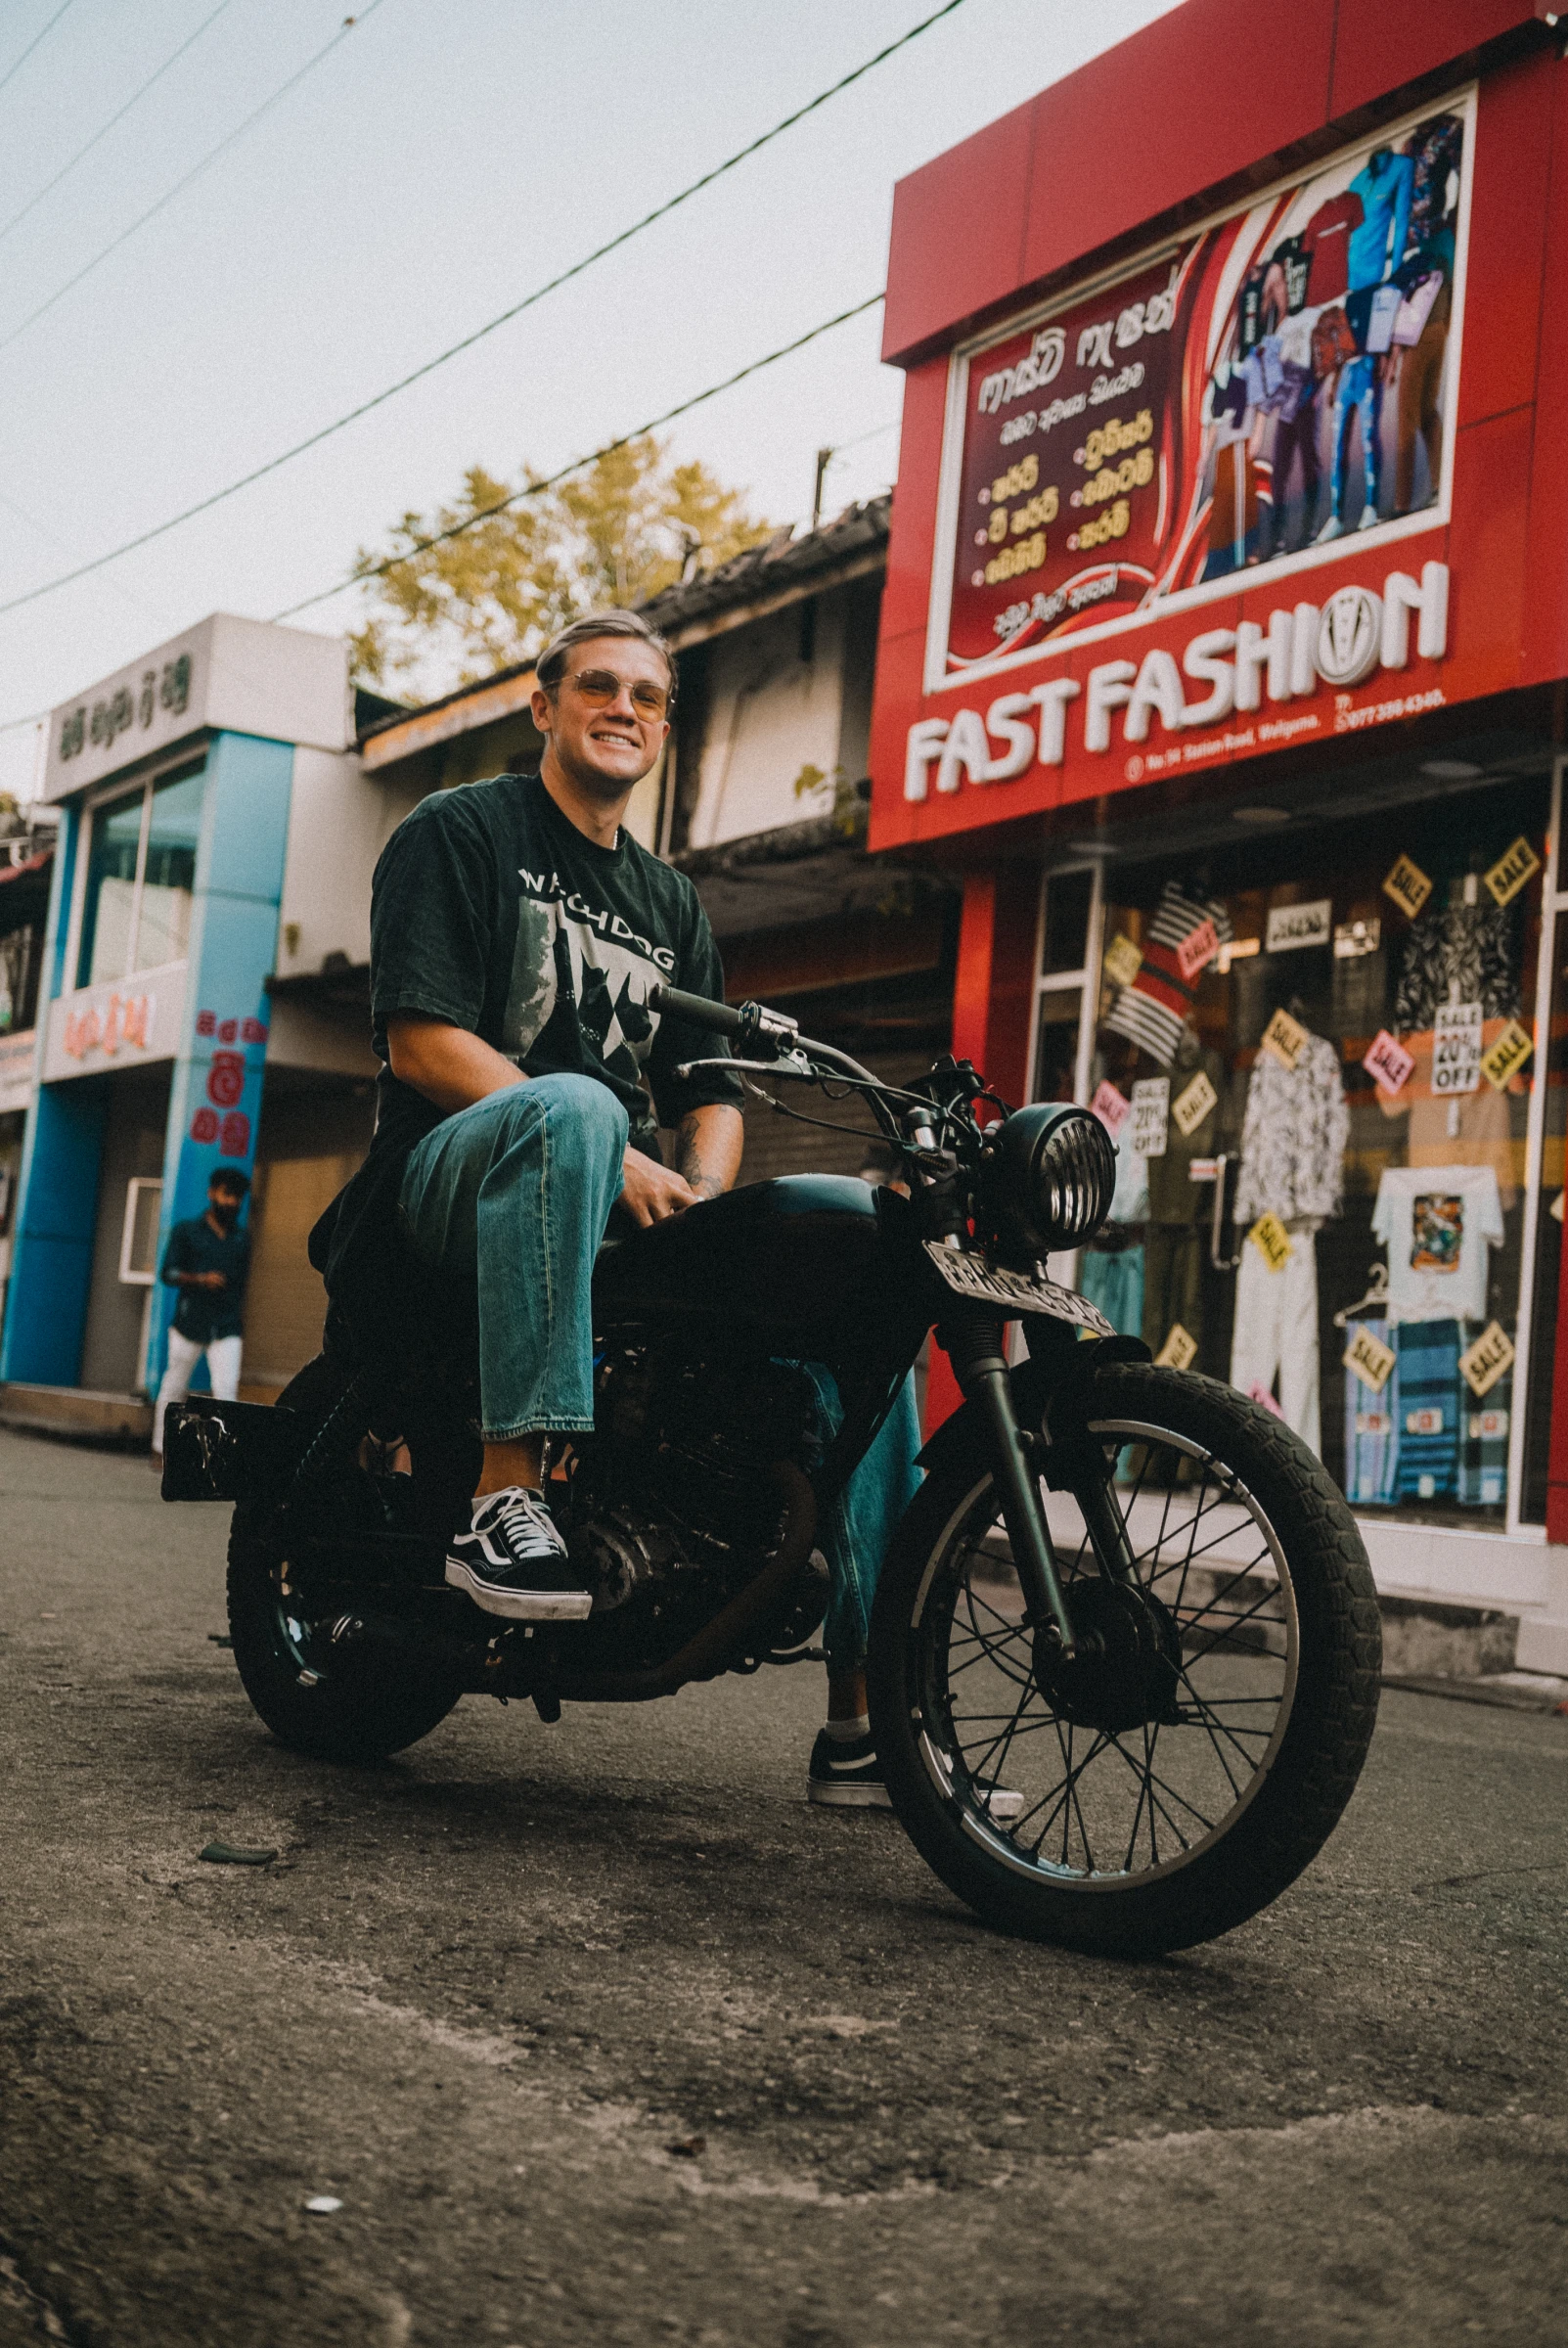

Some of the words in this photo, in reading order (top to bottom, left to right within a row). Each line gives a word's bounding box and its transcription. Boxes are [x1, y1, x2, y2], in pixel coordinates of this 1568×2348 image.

[904, 677, 1081, 802] FAST
[1085, 561, 1450, 753] FASHION
[1490, 845, 1532, 896] SALE
[1436, 1066, 1474, 1088] OFF
[1488, 1031, 1527, 1079] SALE
[1352, 1336, 1388, 1381] SALE
[1469, 1334, 1508, 1383] SALE
